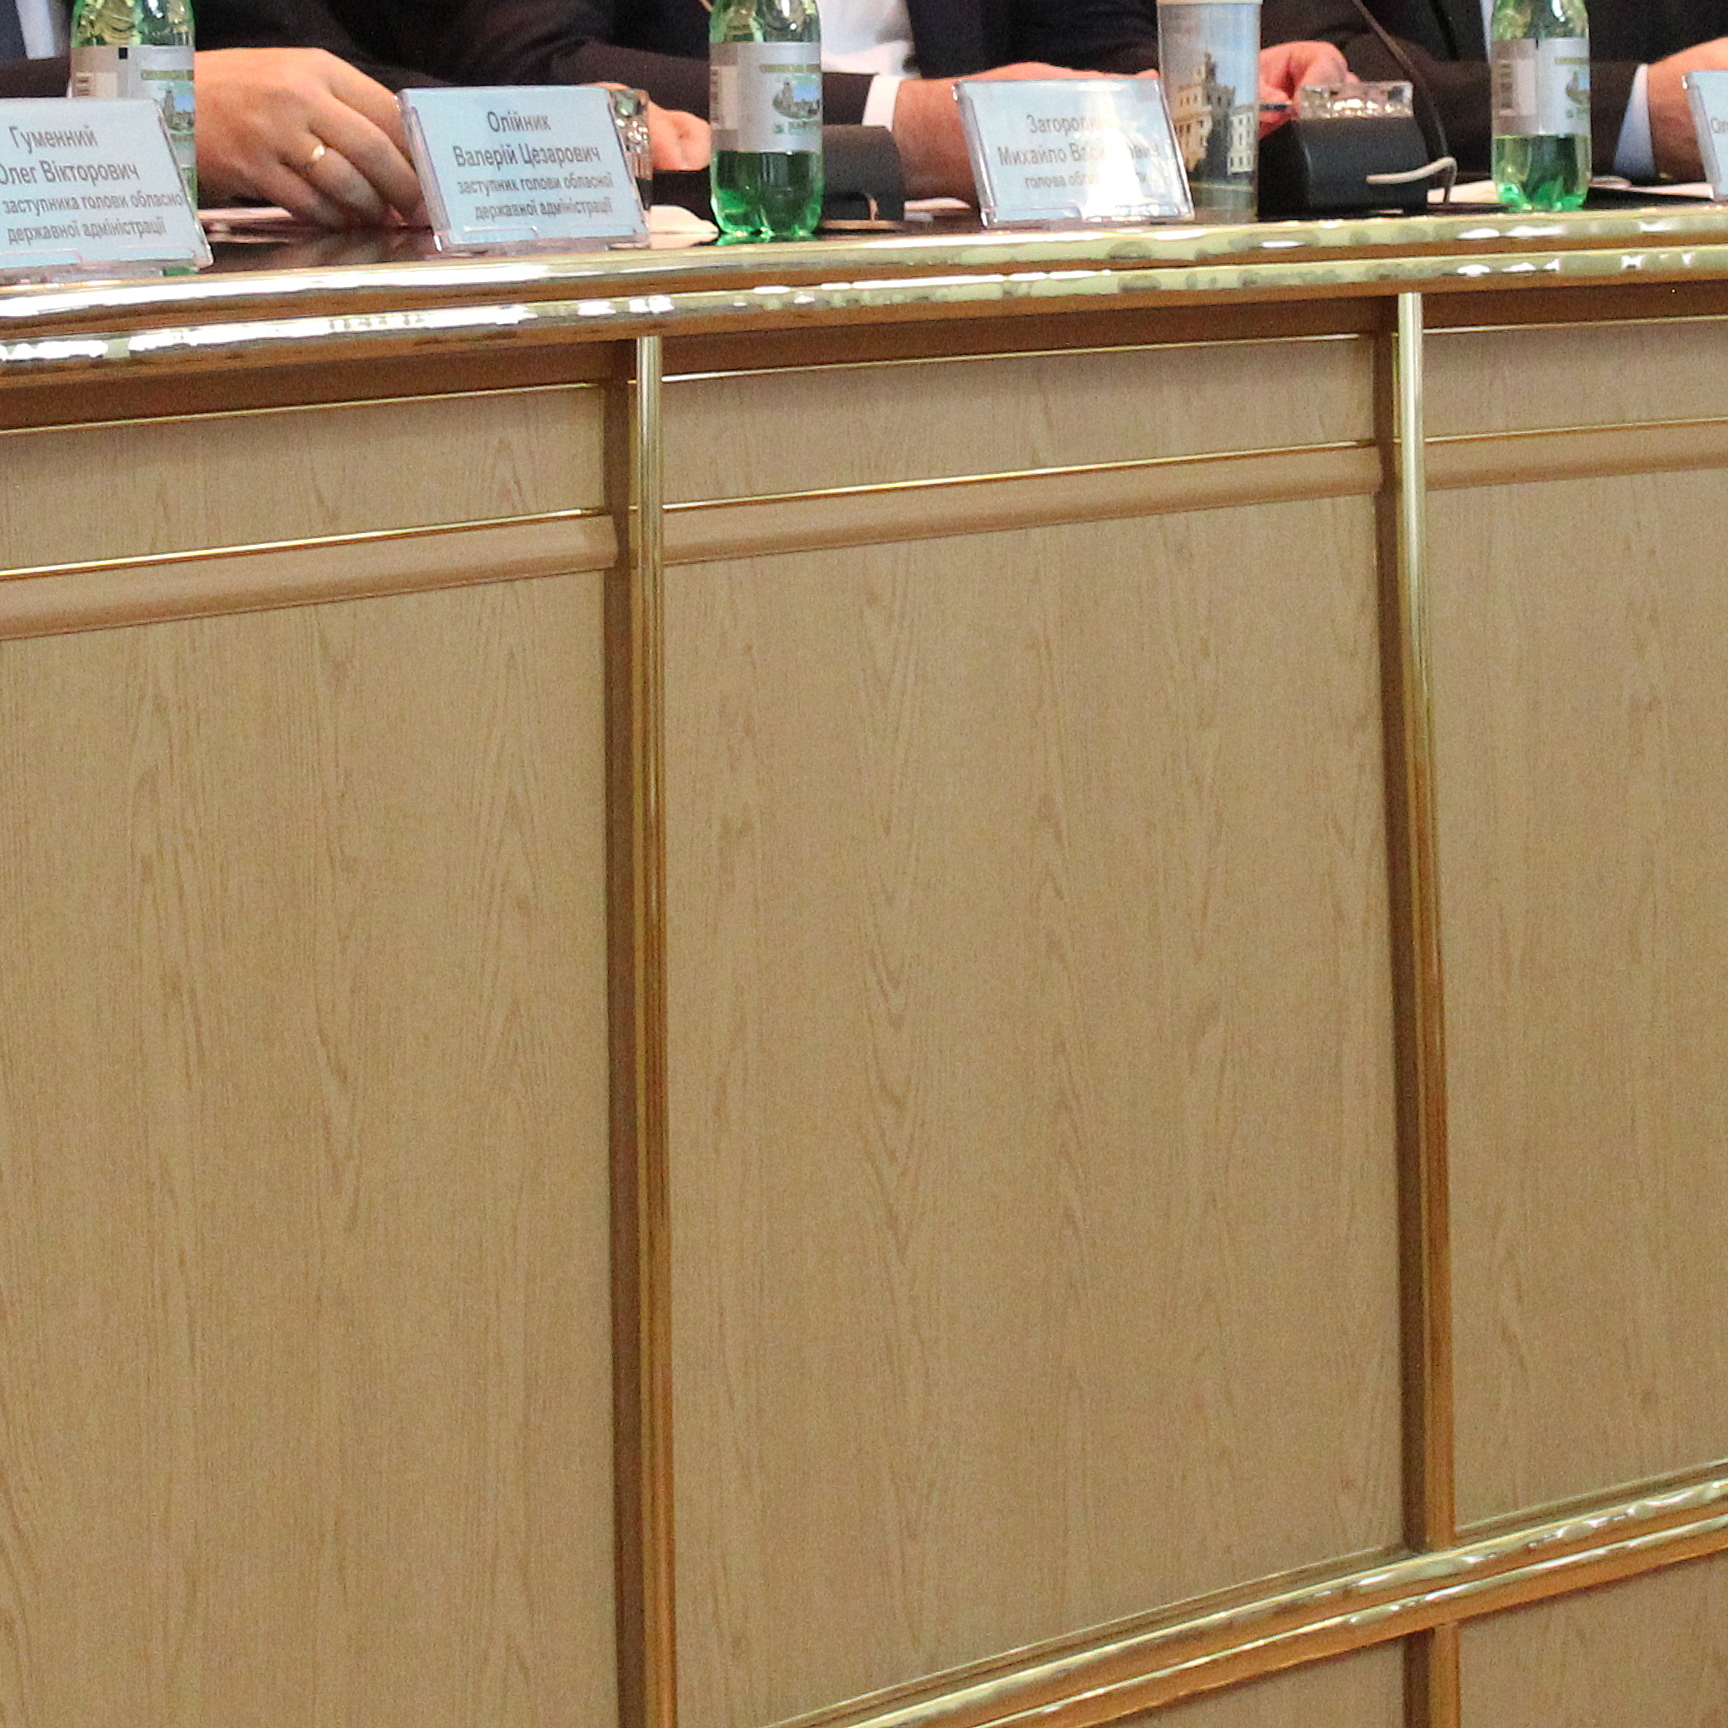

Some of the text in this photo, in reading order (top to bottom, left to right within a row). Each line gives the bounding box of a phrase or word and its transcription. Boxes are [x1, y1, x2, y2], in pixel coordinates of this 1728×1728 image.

[487, 109, 552, 132] Олійник
[8, 125, 98, 154] Гуменний
[453, 143, 601, 169] Валерій Цезарович
[42, 161, 140, 185] Вікторович
[3, 197, 79, 218] заступника
[82, 194, 129, 210] голови
[7, 216, 167, 244] державної адміністрації
